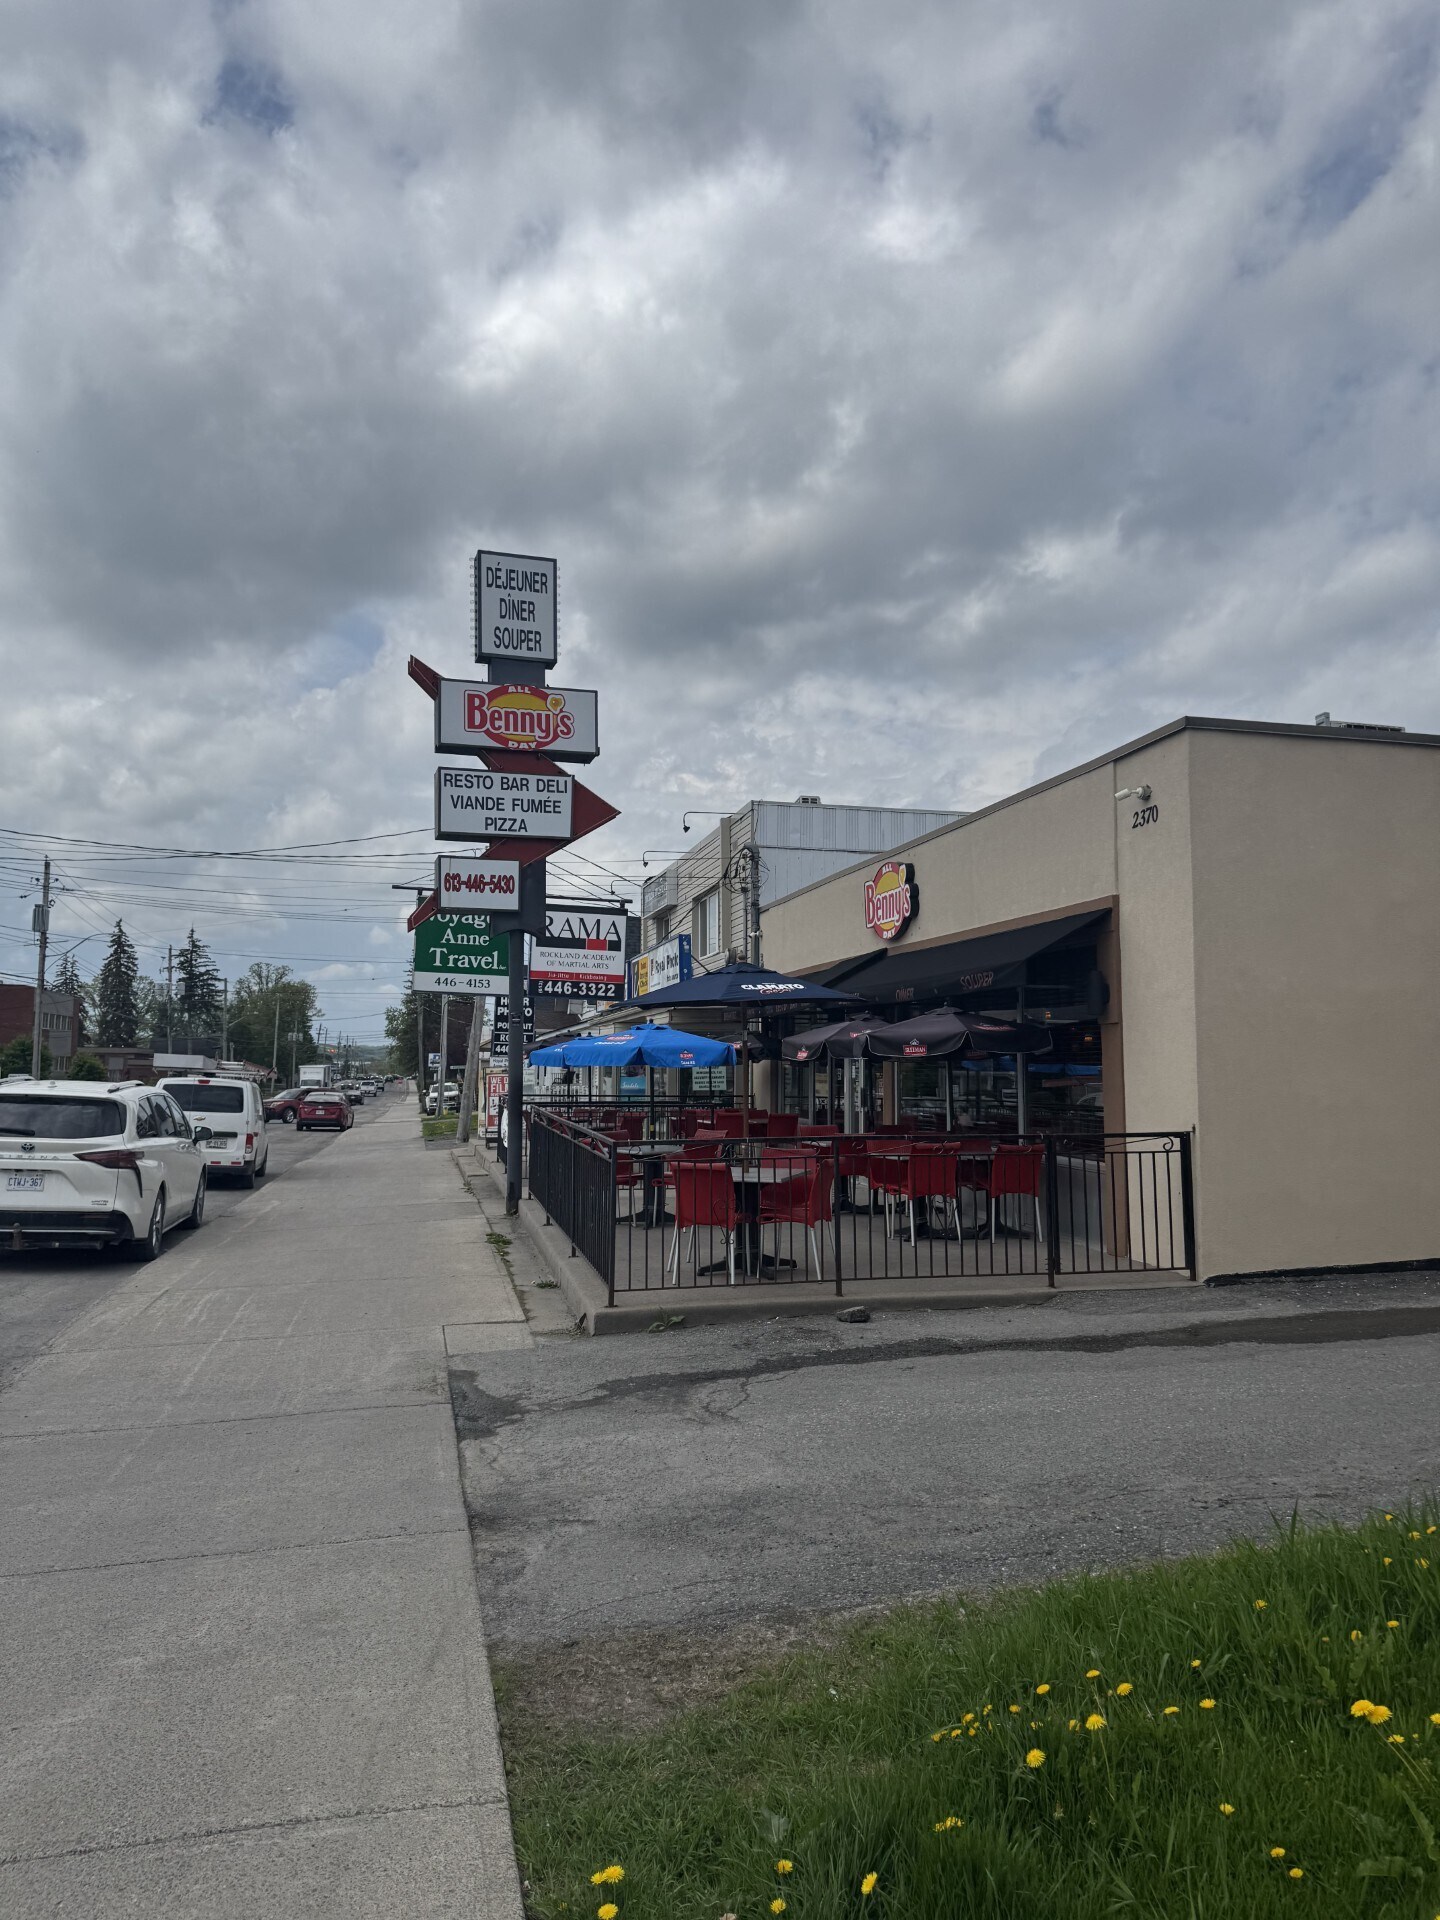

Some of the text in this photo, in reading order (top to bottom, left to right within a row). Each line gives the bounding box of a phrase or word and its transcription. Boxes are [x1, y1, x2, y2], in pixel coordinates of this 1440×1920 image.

[486, 562, 548, 594] DÉJEUNER
[499, 593, 536, 622] DÎNER
[493, 626, 542, 652] SOUPER
[507, 685, 531, 694] ALL
[465, 691, 574, 742] Benny's
[508, 741, 537, 749] DAY
[443, 773, 568, 794] RESTO BAR DELI
[450, 795, 562, 814] VIANDE FUMÉE
[484, 817, 528, 832] PIZZA
[1131, 804, 1159, 829] 2370
[882, 863, 893, 874] ALL
[444, 872, 515, 895] 613-446-5430
[864, 883, 911, 927] Benny's
[429, 913, 490, 929] oyag
[545, 915, 622, 940] RAMA
[440, 928, 490, 946] Anne
[882, 928, 896, 939] DAY
[429, 947, 499, 970] Travel
[540, 951, 580, 960] ROCKLAND
[558, 961, 590, 969] MARTIAL
[434, 977, 491, 989] 446-4153
[544, 980, 616, 997] 446-3322
[490, 1076, 502, 1084] WE
[30, 1177, 43, 1187] 367
